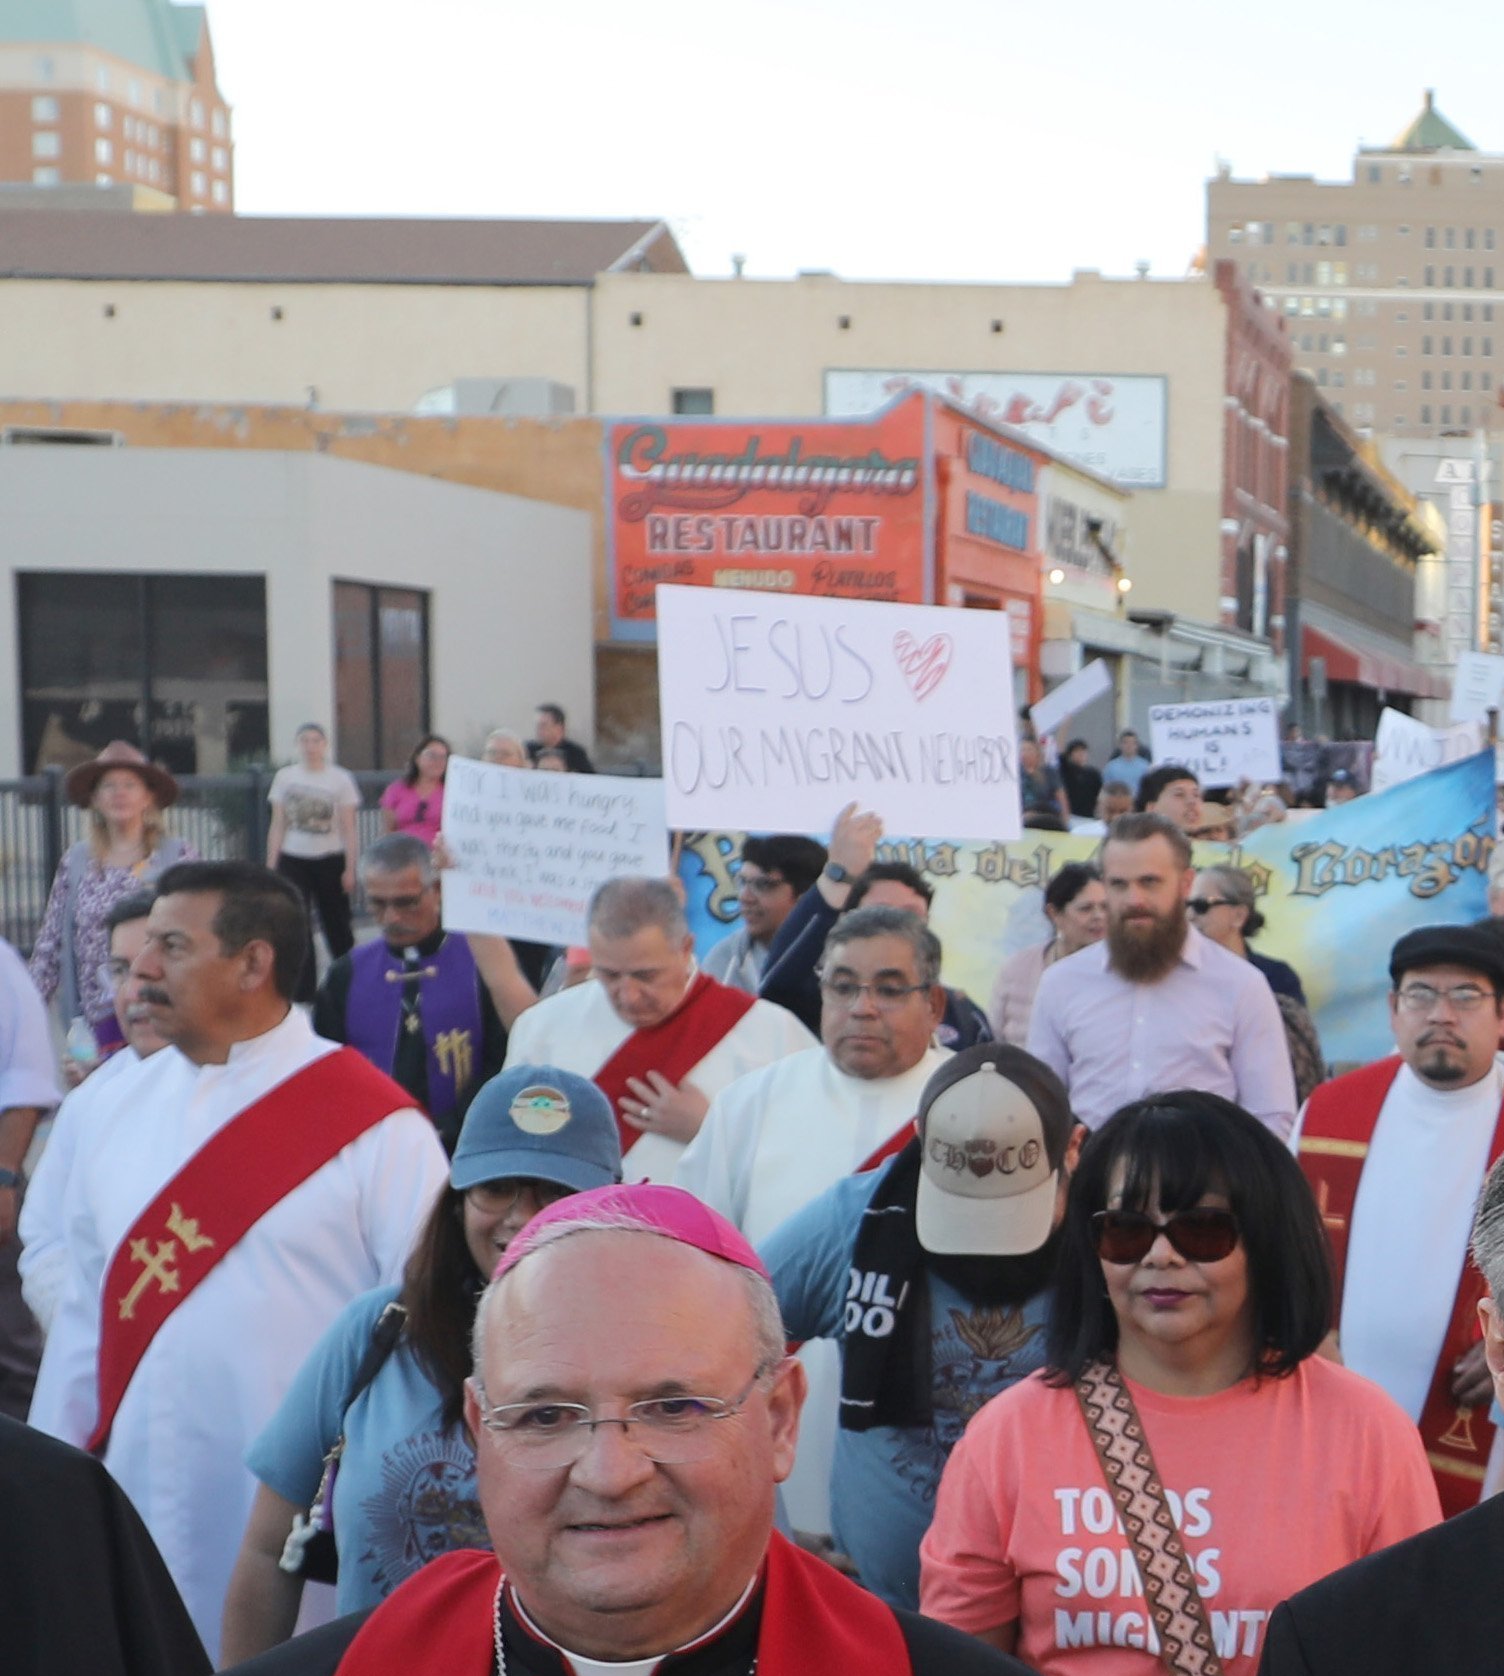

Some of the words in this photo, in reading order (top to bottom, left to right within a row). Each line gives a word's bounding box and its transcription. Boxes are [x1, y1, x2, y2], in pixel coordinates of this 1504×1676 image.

[648, 514, 880, 554] RESTAURANT
[714, 569, 795, 587] MENUDO
[705, 613, 873, 702] JESUS
[1151, 700, 1270, 720] DEMONIZING
[1167, 721, 1252, 739] HUMANS
[671, 721, 755, 795] OUR
[757, 725, 912, 785] MIGRANT
[918, 731, 1017, 784] NEIGHBOR
[1204, 740, 1219, 753] IS
[975, 841, 1053, 888] del
[1290, 812, 1496, 898] Corazón
[1054, 1486, 1212, 1537] TOS
[1055, 1547, 1221, 1598] SOS
